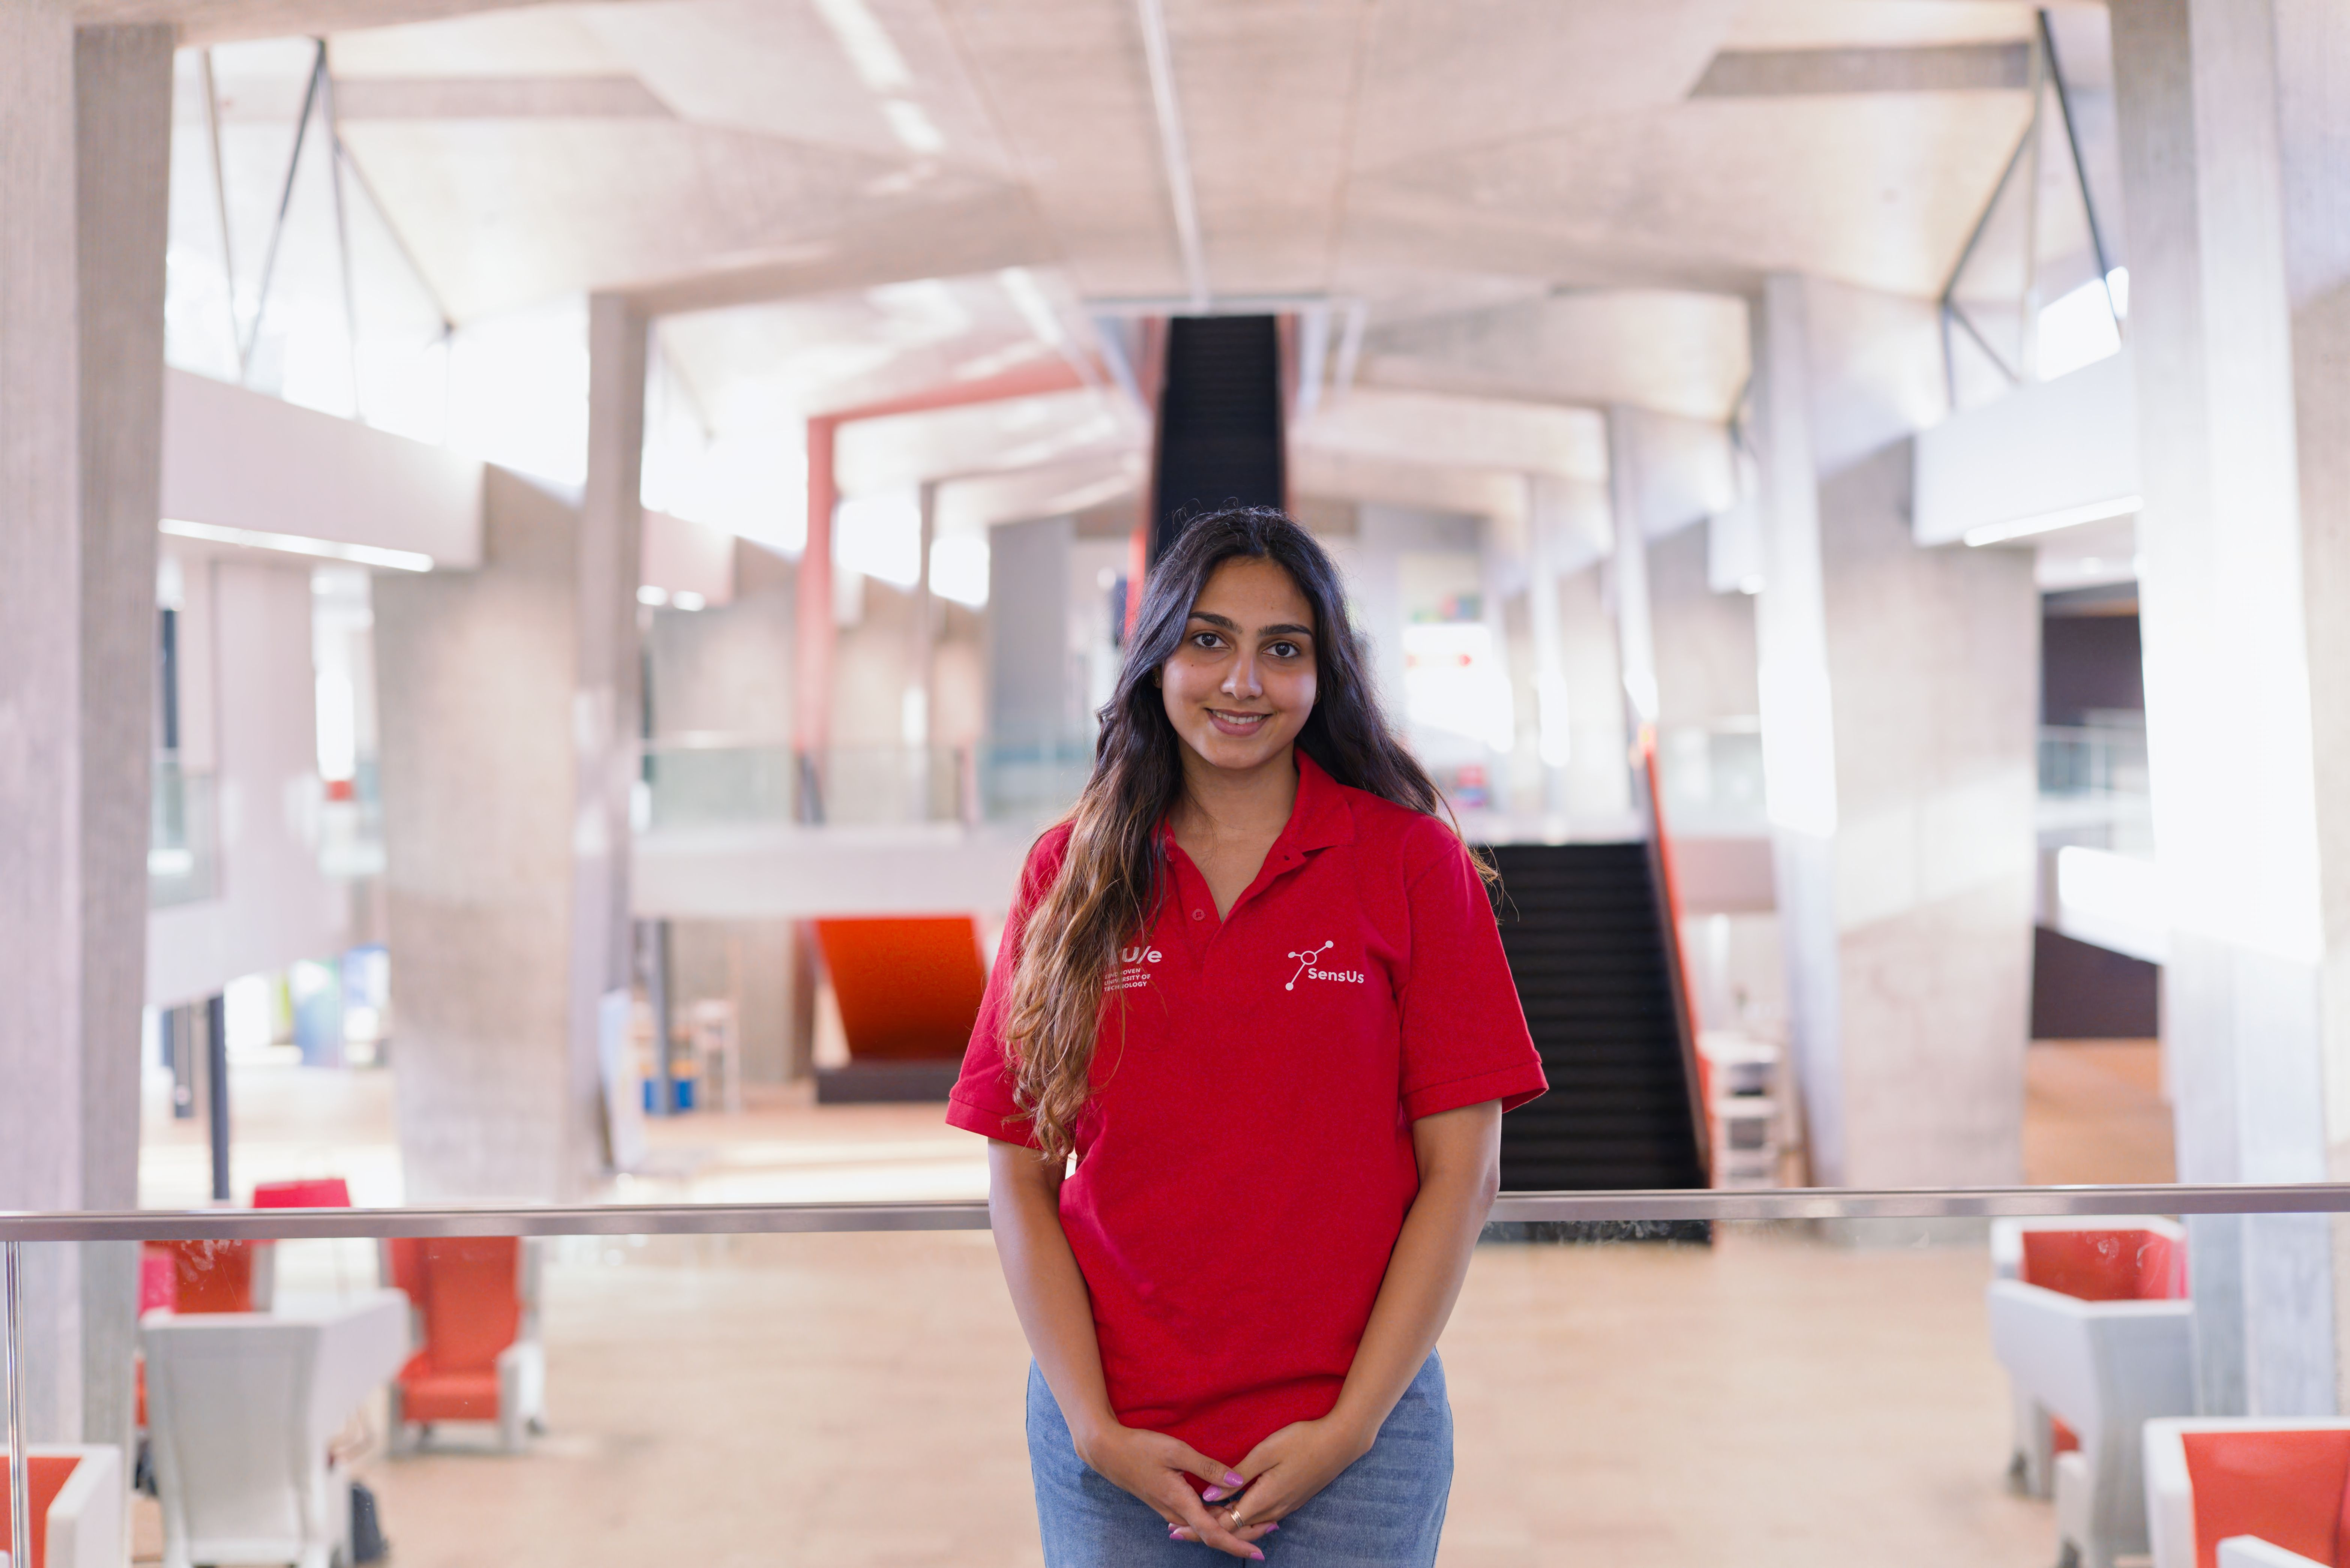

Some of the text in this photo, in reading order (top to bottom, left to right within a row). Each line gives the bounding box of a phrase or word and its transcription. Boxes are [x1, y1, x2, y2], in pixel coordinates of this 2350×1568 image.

[1111, 946, 1162, 964] U/e
[1104, 968, 1140, 979] EINDOVEN
[1104, 975, 1140, 985] UNIVRSITY
[1308, 968, 1364, 984] SensUs
